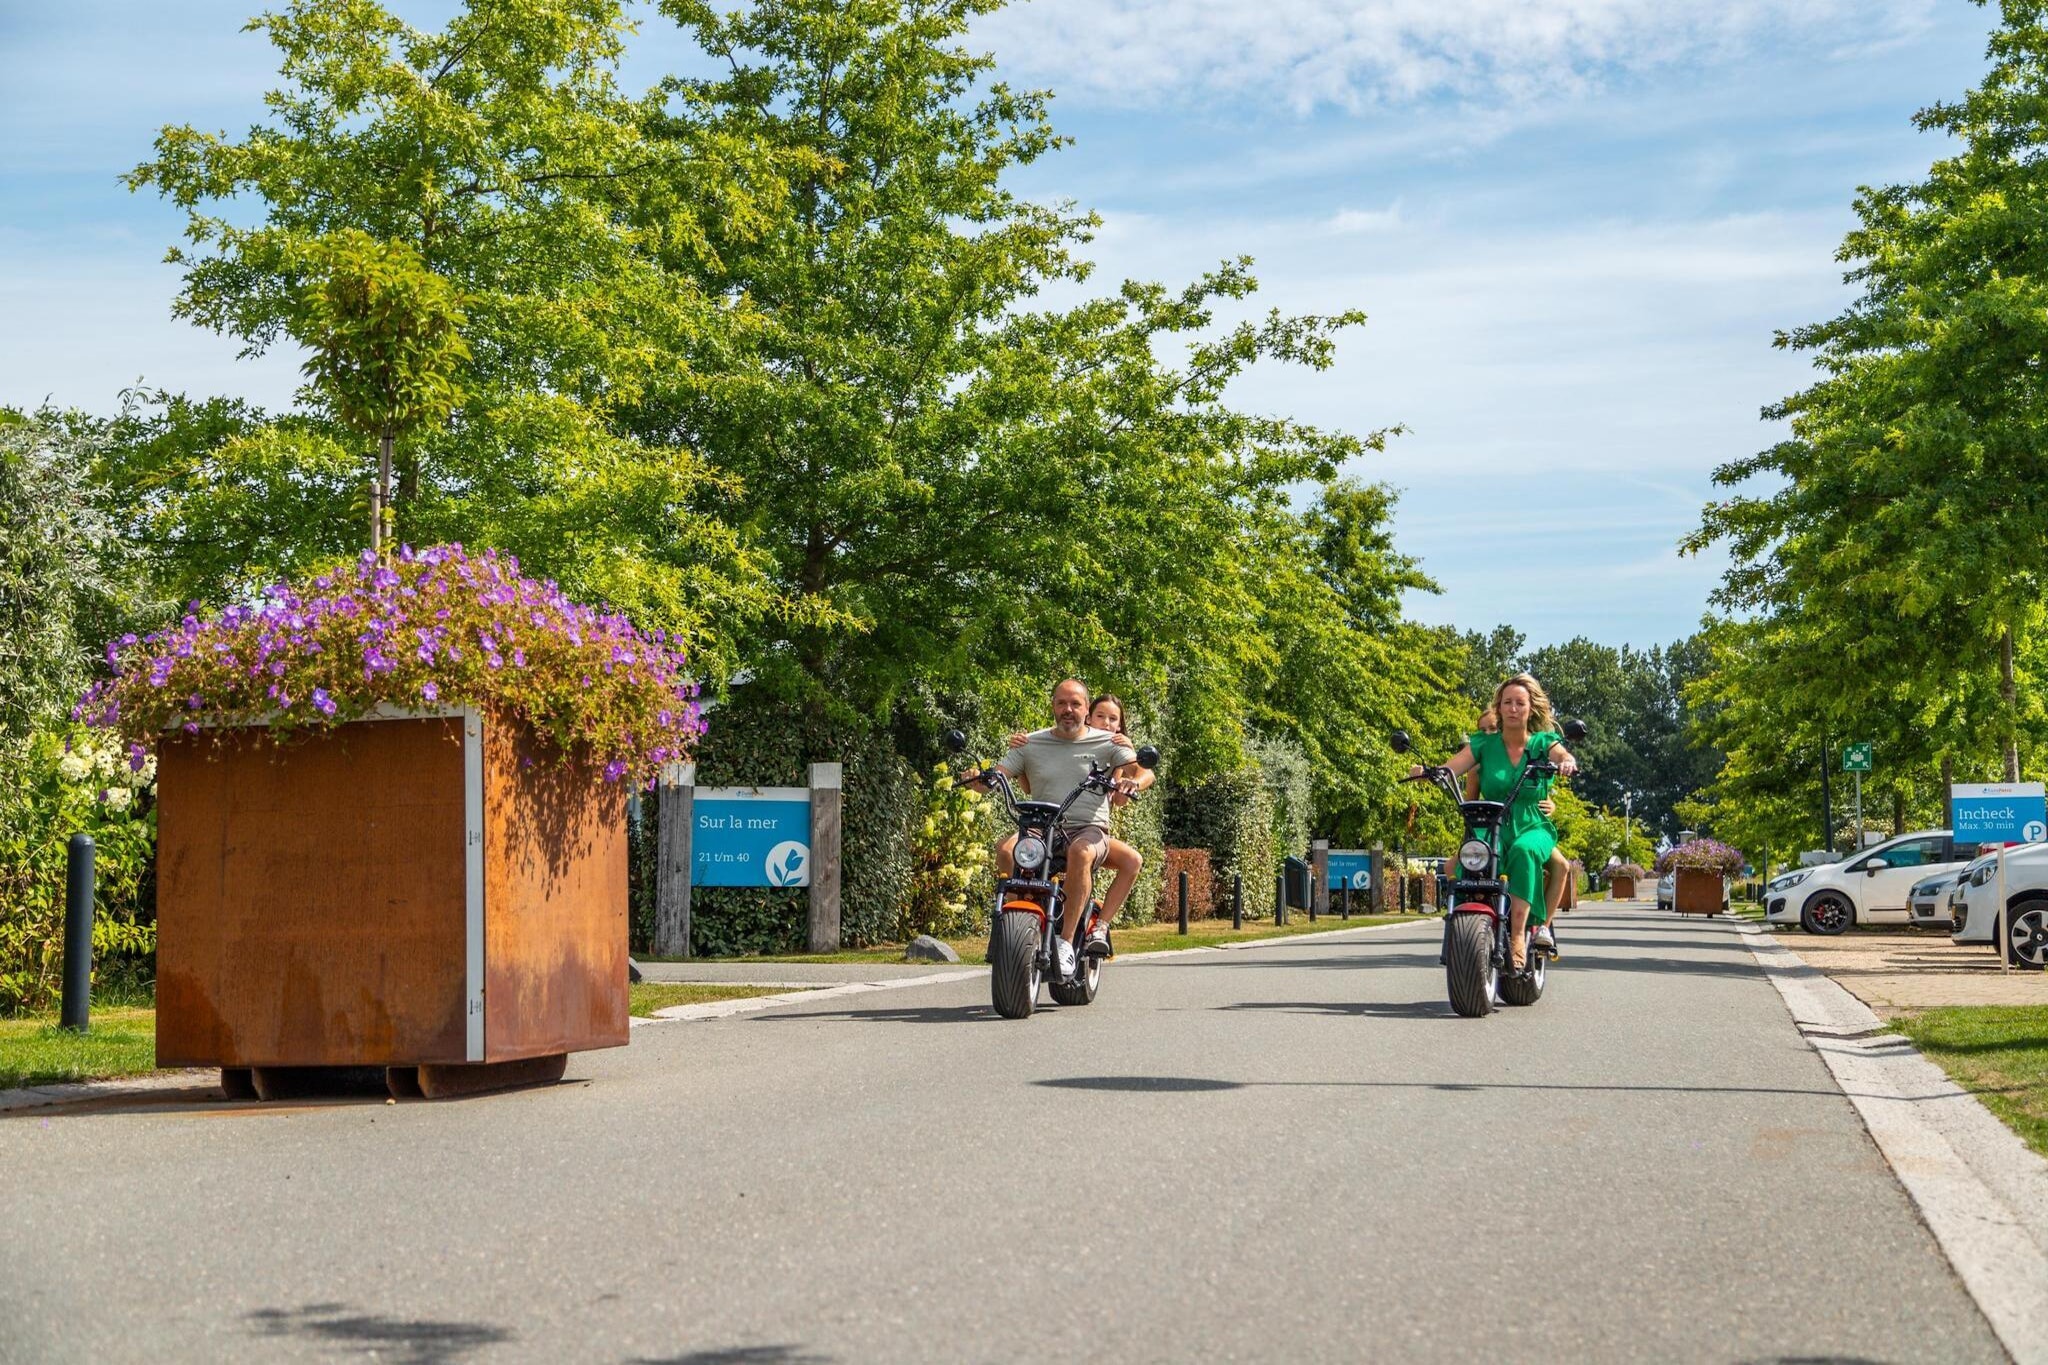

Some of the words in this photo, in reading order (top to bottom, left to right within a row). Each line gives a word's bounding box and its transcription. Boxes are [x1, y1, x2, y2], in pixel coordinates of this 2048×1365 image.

[1959, 807, 2015, 820] Incheck
[699, 815, 725, 829] Sur
[729, 815, 742, 829] la
[747, 818, 778, 829] mer
[1959, 822, 1980, 830] Max.
[1983, 822, 1993, 830] 30
[1996, 821, 2015, 829] min
[2029, 825, 2042, 840] P
[699, 853, 711, 862] 21
[714, 852, 734, 863] t/m
[736, 853, 750, 862] 40
